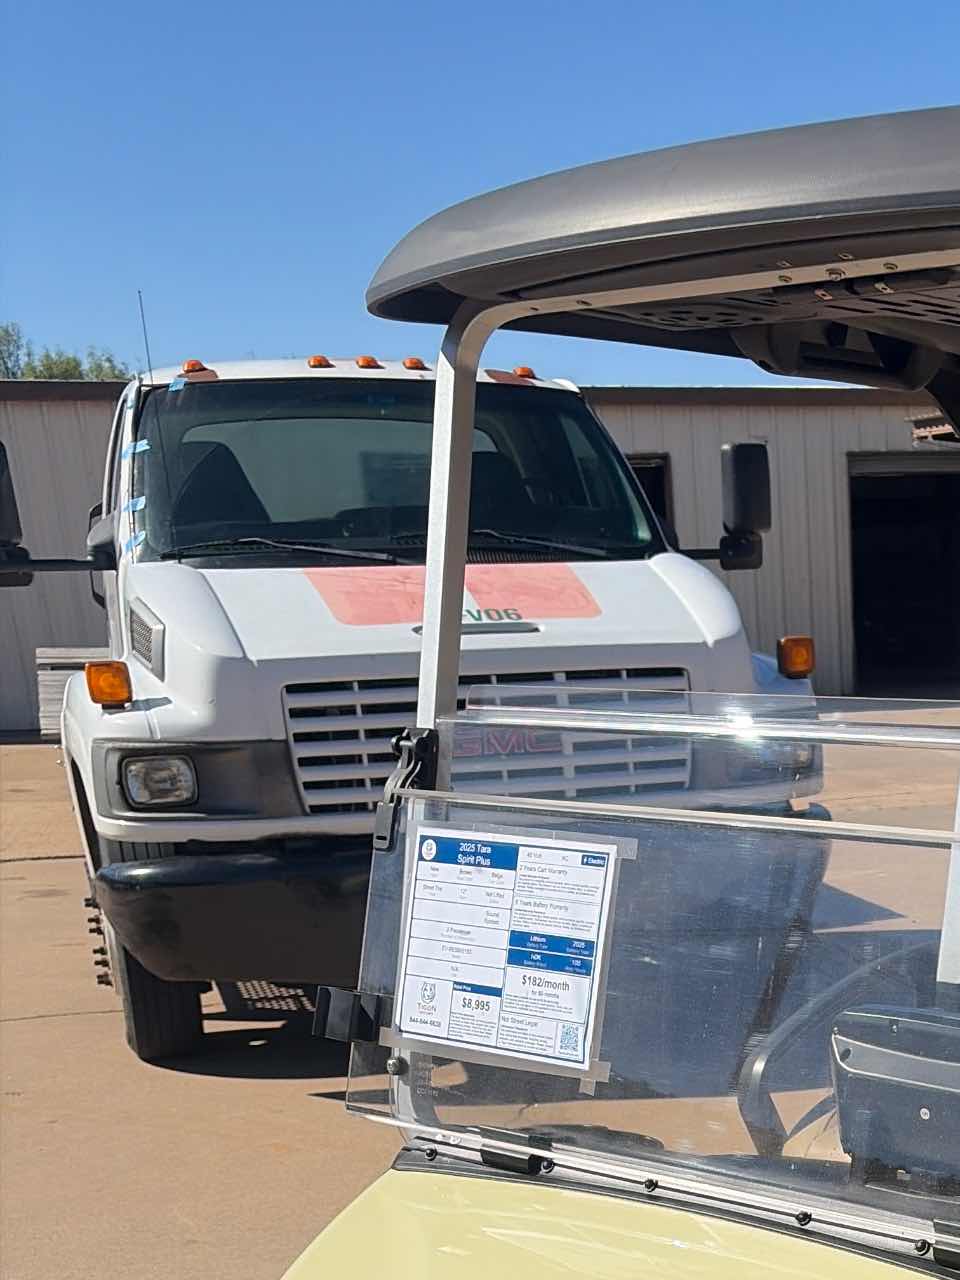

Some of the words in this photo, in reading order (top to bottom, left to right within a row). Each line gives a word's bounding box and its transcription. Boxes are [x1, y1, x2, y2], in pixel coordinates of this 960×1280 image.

[459, 843, 476, 852] 2025
[477, 844, 492, 854] Tara
[457, 854, 475, 866] Spirit
[476, 856, 491, 866] Plus
[521, 974, 570, 992] $182/month
[462, 997, 491, 1012] $8,995
